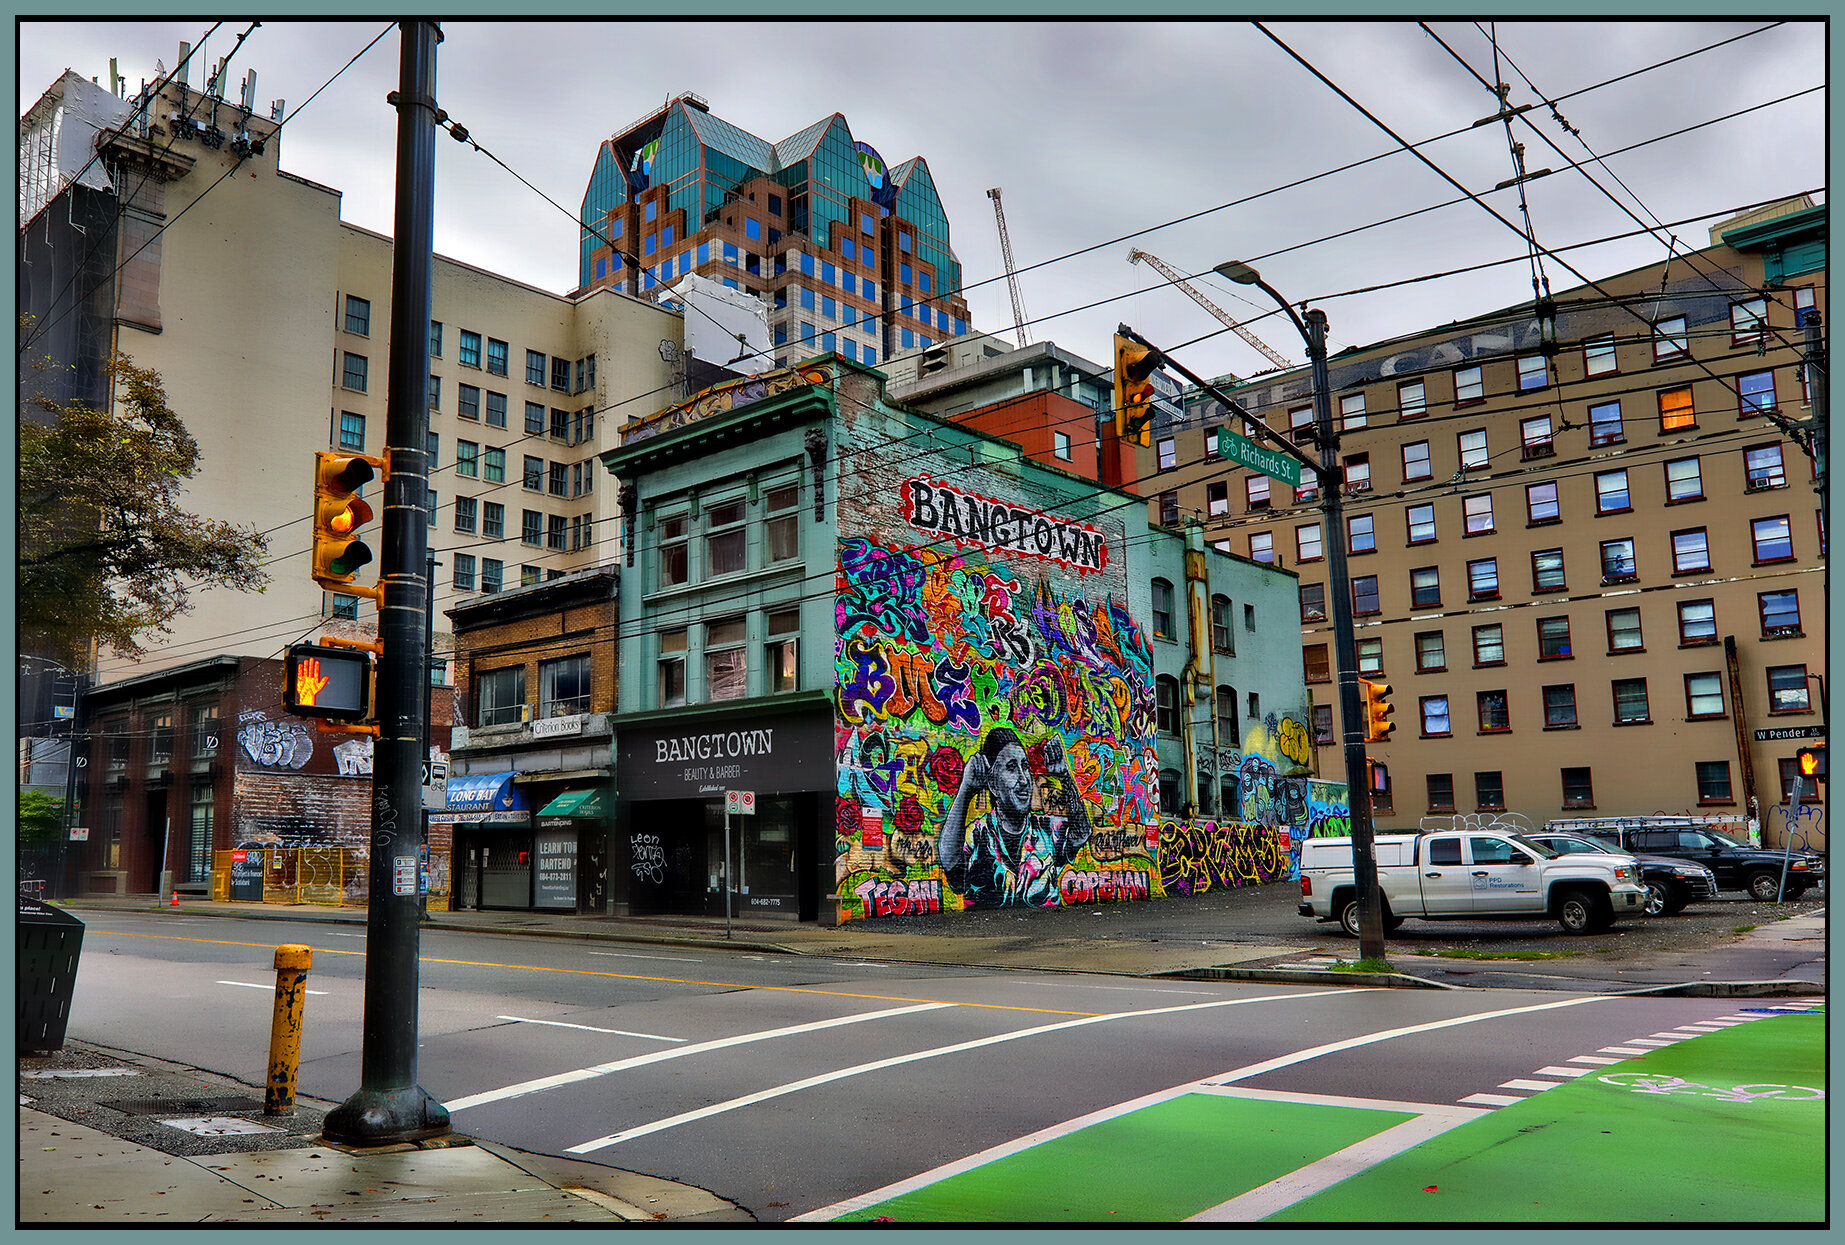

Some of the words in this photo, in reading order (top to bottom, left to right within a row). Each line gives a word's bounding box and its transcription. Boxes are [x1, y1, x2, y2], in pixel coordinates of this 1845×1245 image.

[1240, 442, 1279, 474] Richards
[1281, 460, 1294, 480] St.
[909, 480, 1105, 569] BANGTOWN
[534, 721, 560, 735] Criterion
[560, 719, 580, 731] Books
[1757, 731, 1766, 740] W
[1770, 729, 1805, 739] Pender
[655, 729, 773, 763] BANGTOWN
[684, 767, 708, 781] BEAUTY
[709, 766, 715, 779] &
[715, 764, 740, 779] BARBER
[450, 790, 476, 802] LONG
[476, 789, 497, 800] BAY
[446, 802, 490, 812] STAURANT
[540, 842, 562, 854] LEARN
[563, 841, 573, 854] TO
[540, 858, 572, 870] BARTEND
[1060, 870, 1151, 905] COPEMAN
[854, 877, 940, 917] TEGAN
